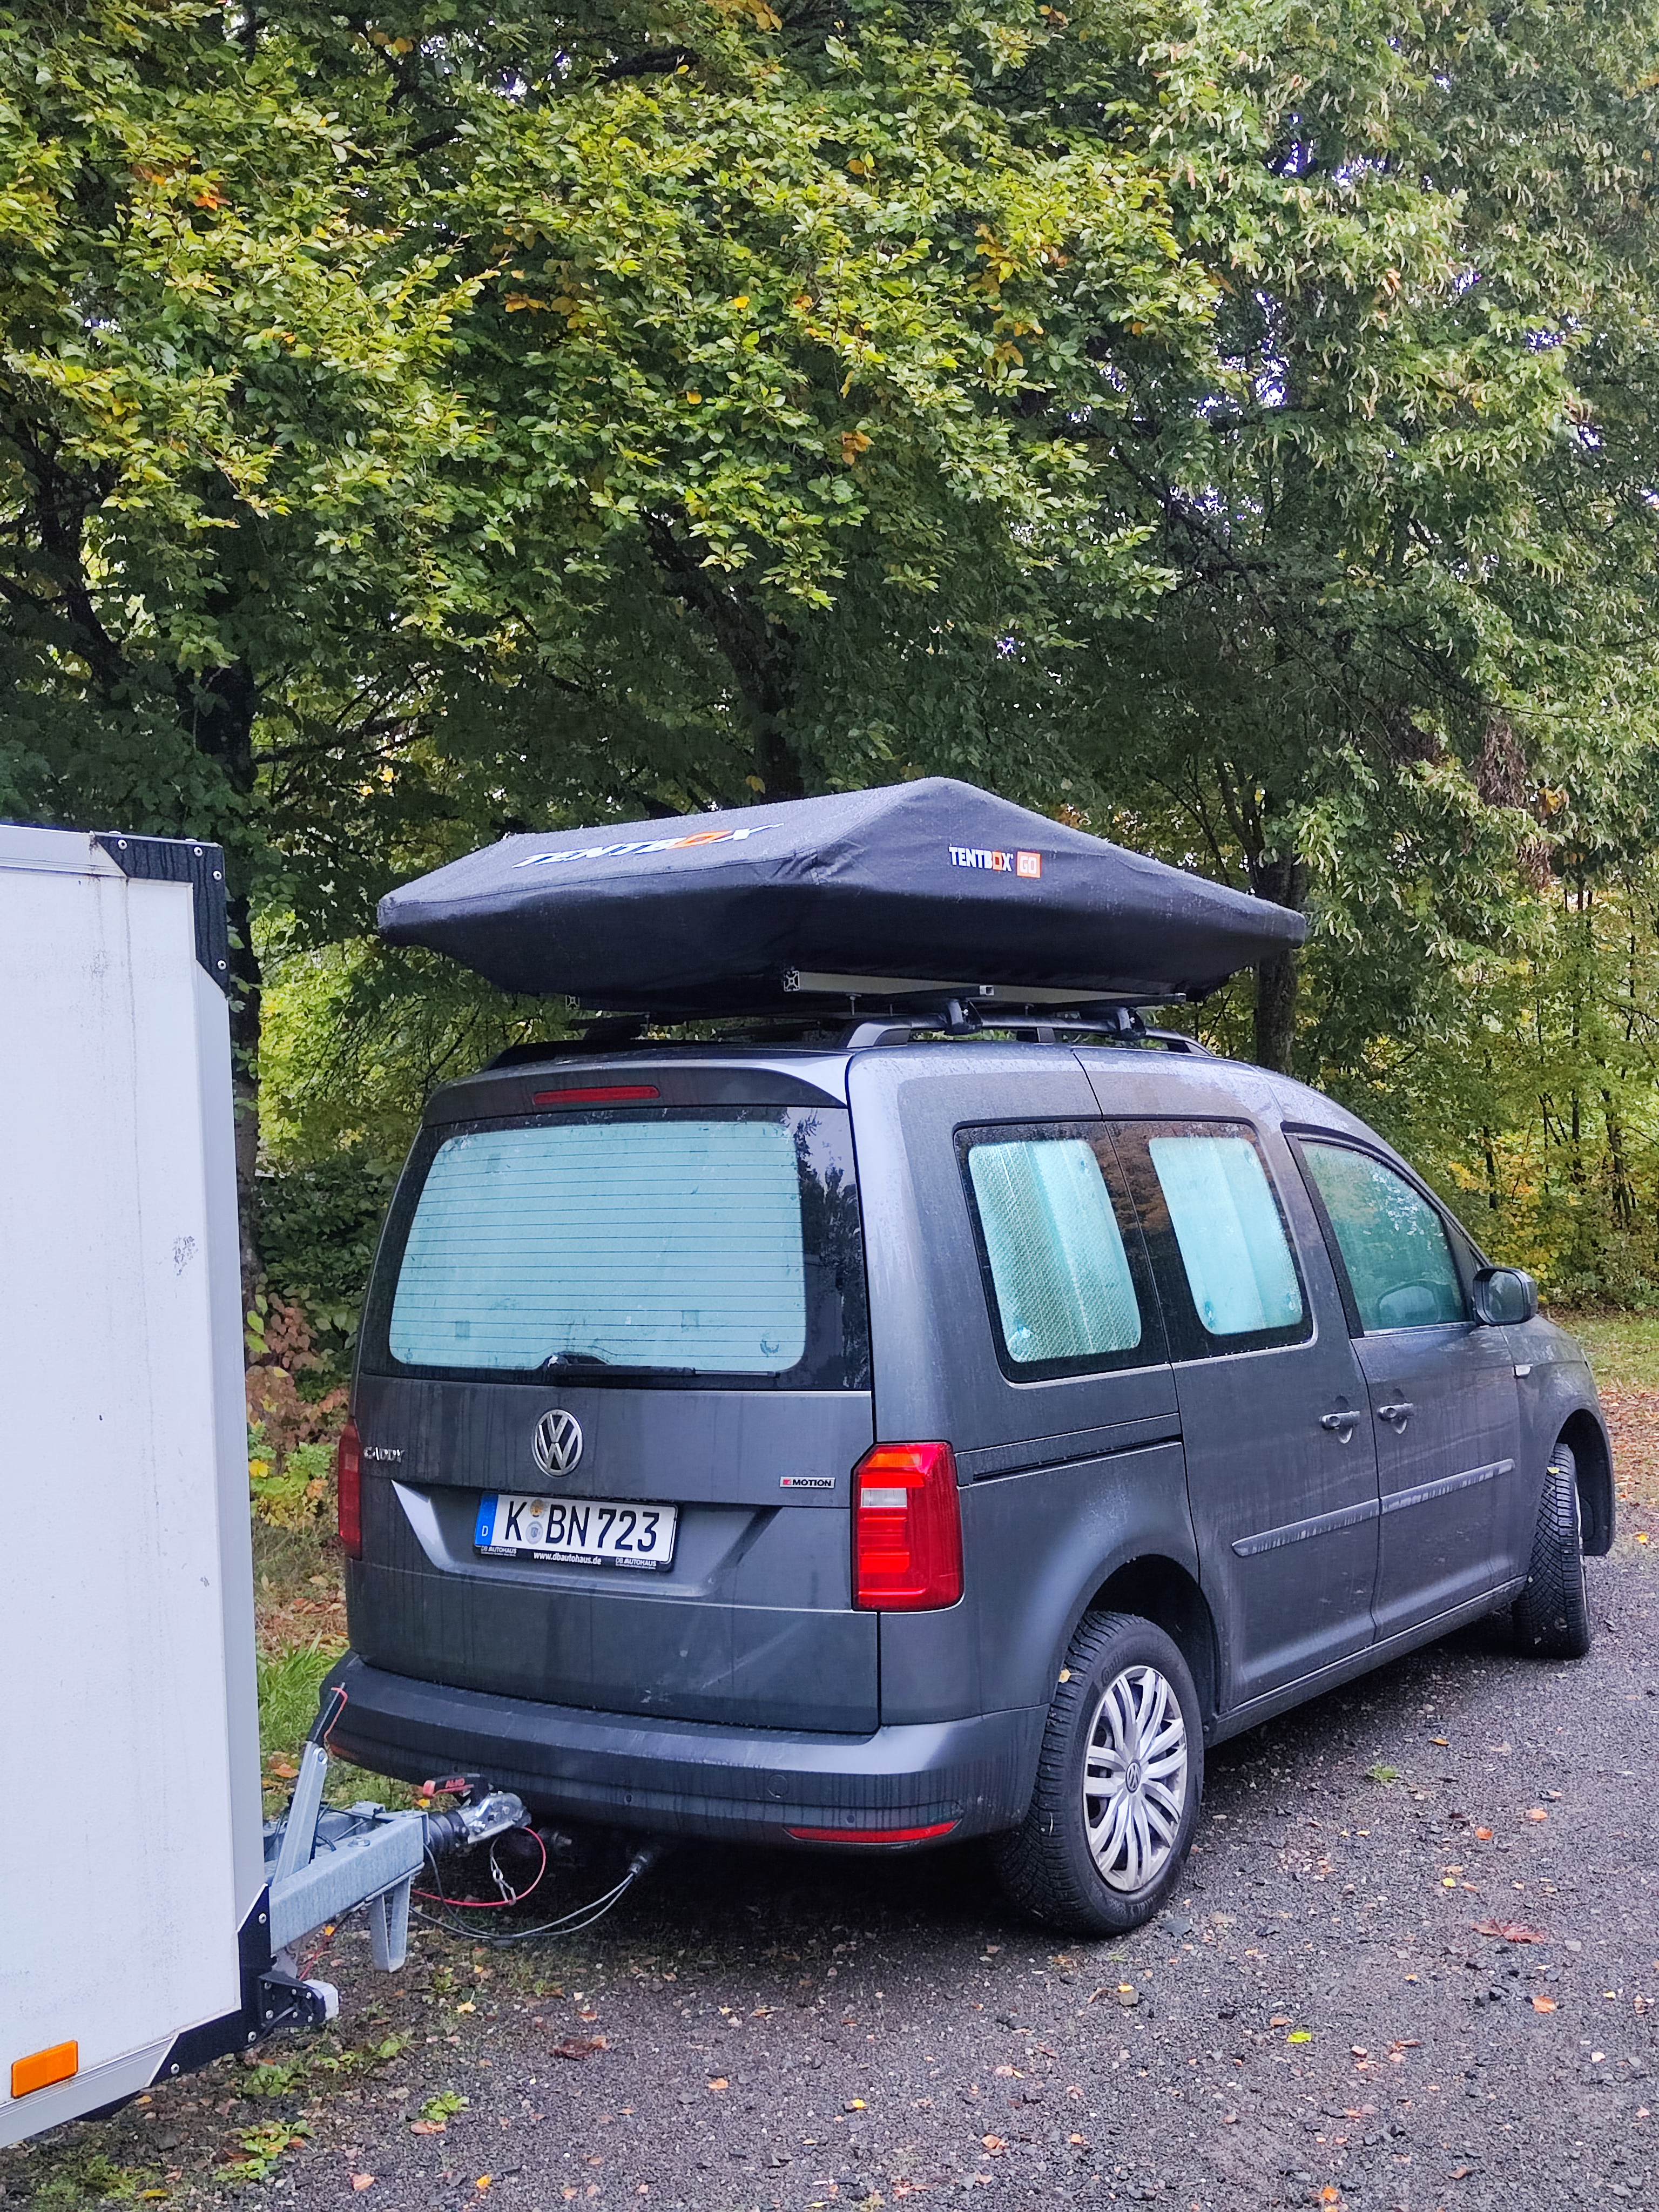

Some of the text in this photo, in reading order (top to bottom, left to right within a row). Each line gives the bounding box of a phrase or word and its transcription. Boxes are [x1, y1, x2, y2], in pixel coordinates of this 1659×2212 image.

[1020, 855, 1037, 874] GO
[363, 1446, 405, 1463] CADDY
[481, 1525, 489, 1537] D
[505, 1501, 660, 1553] K BN 723
[534, 1552, 602, 1566] www.dbautohaus.de
[624, 1558, 657, 1567] AUTOHAUS
